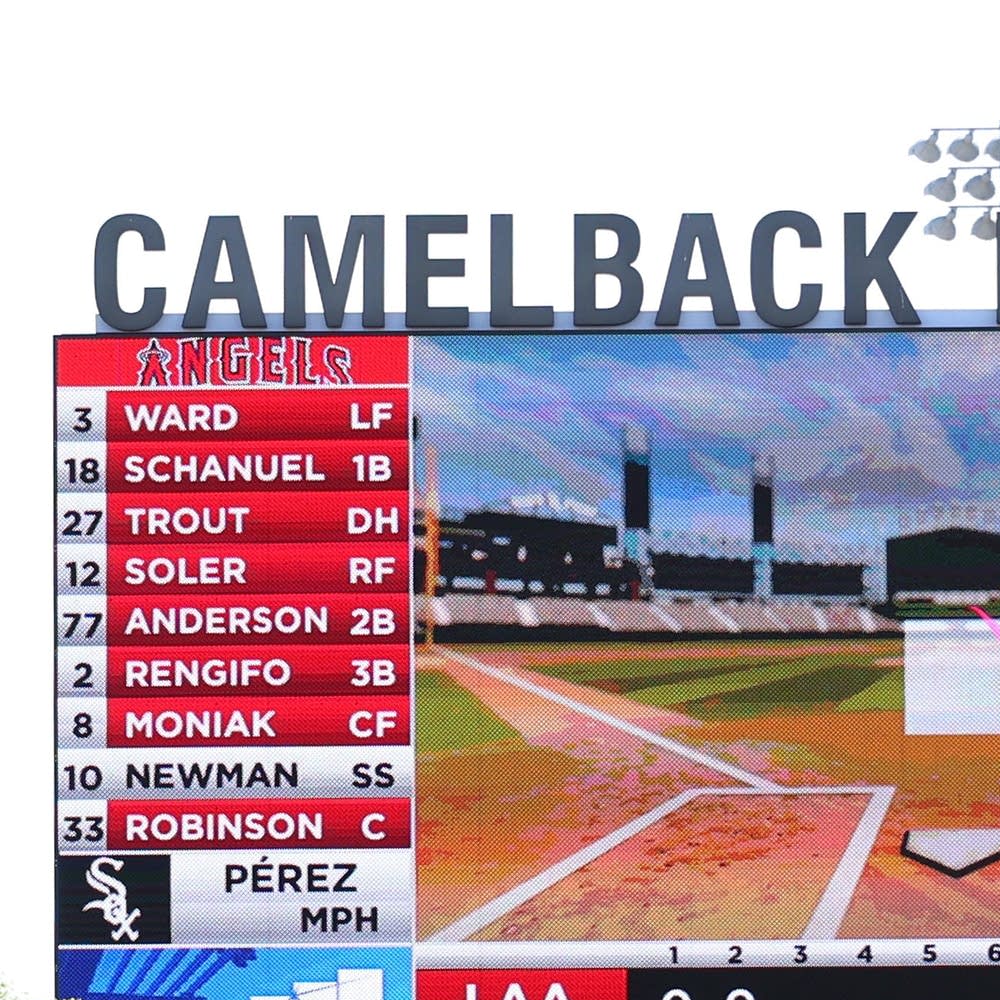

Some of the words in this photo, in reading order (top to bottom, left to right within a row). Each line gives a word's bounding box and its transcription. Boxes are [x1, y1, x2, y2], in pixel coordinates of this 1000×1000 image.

[94, 210, 921, 331] CAMELBACK
[73, 407, 92, 433] 3
[124, 404, 239, 431] WARD
[349, 403, 393, 430] LF
[64, 458, 100, 483] 18
[124, 455, 325, 482] SCHANUEL
[352, 454, 392, 481] 1B
[62, 510, 102, 536] 27
[124, 507, 250, 535] TROUT
[347, 507, 399, 534] DH
[66, 561, 100, 587] 12
[125, 557, 247, 584] SOLER
[349, 557, 396, 584] RF
[62, 613, 102, 639] 77
[124, 607, 328, 635] ANDERSON
[350, 607, 396, 635] 2B
[73, 662, 93, 688] 2
[126, 659, 291, 687] RENGIFO
[351, 659, 396, 687] 3B
[72, 713, 93, 738] 8
[126, 710, 276, 738] MONIAK
[348, 710, 398, 738] CF
[64, 765, 102, 791] 10
[126, 763, 299, 789] NEWMAN
[352, 763, 395, 789] SS
[64, 817, 104, 842] 33
[126, 813, 323, 842] ROBINSON
[361, 813, 386, 840] C
[225, 857, 358, 893] PÉREZ
[301, 907, 379, 933] MPH
[670, 945, 679, 964] 1
[728, 945, 742, 964] 2
[794, 945, 807, 964] 3
[858, 945, 873, 963] 4
[923, 944, 937, 962] 5
